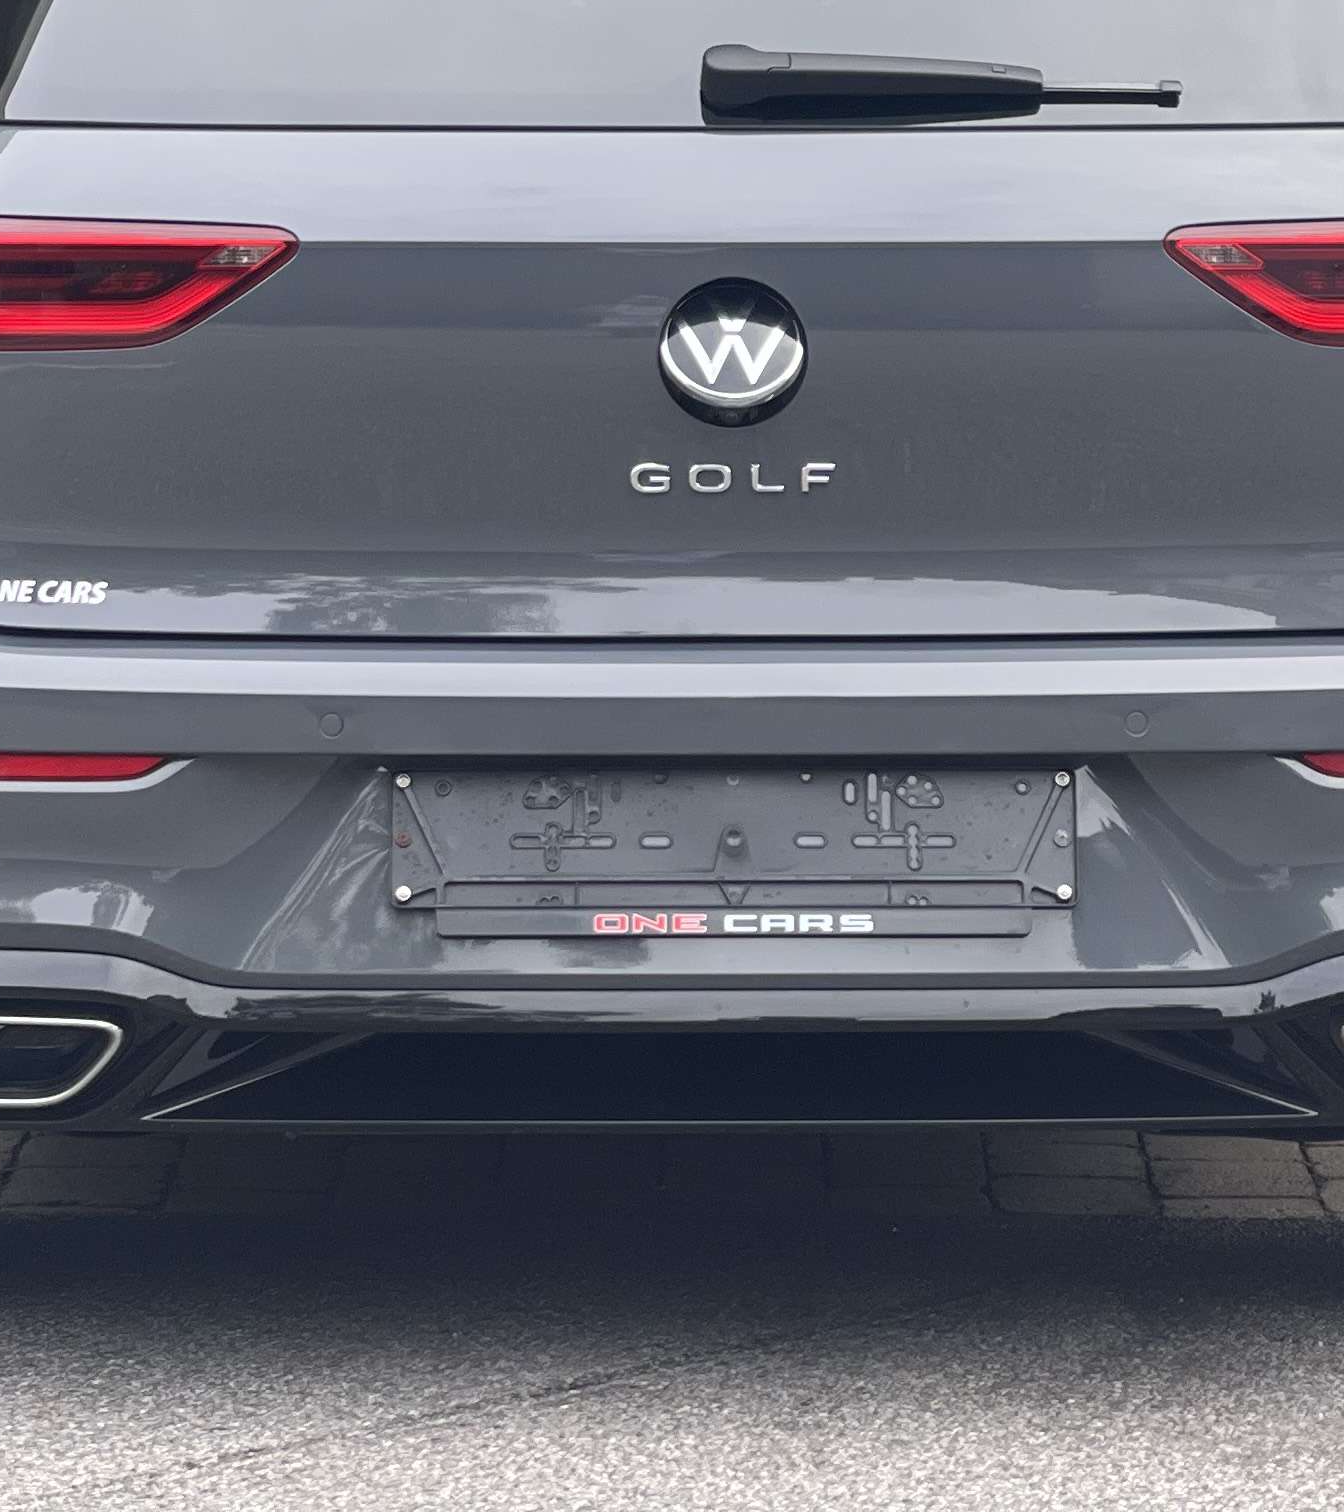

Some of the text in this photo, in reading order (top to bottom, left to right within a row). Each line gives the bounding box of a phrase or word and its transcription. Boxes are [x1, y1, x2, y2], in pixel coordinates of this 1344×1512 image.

[629, 461, 837, 494] GOLF
[37, 580, 109, 605] CARS
[593, 913, 875, 934] ONE CARS
